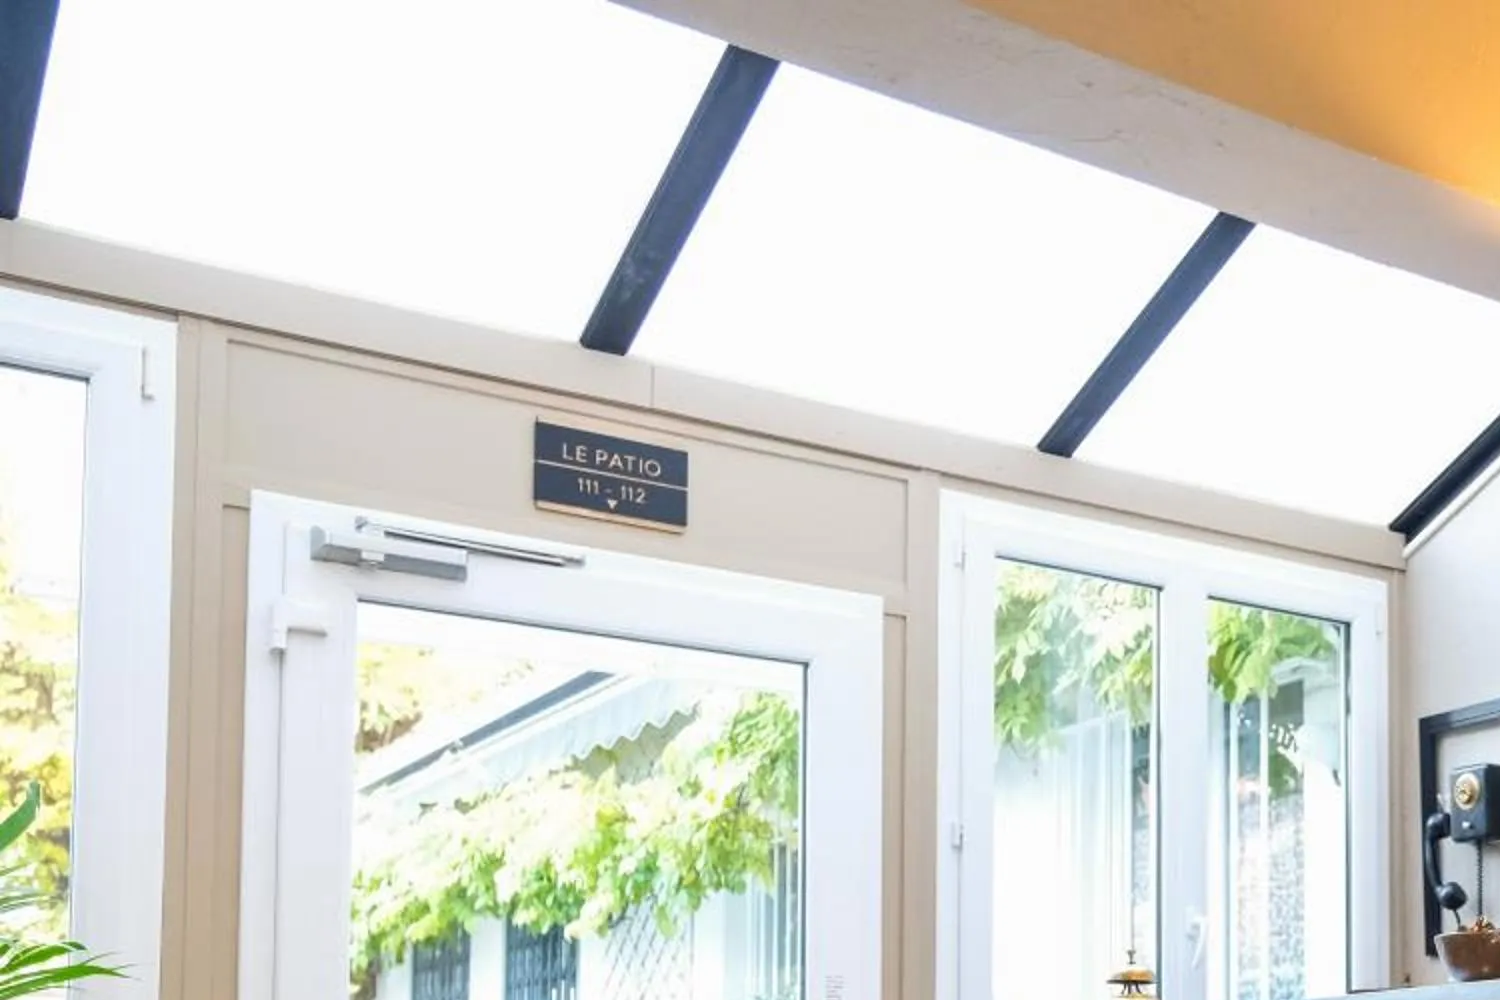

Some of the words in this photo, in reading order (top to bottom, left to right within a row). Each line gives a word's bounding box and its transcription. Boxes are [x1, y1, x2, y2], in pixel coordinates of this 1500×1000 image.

[562, 442, 588, 464] LE
[595, 449, 661, 477] PATIO
[577, 476, 599, 495] 111
[620, 484, 646, 505] 112
